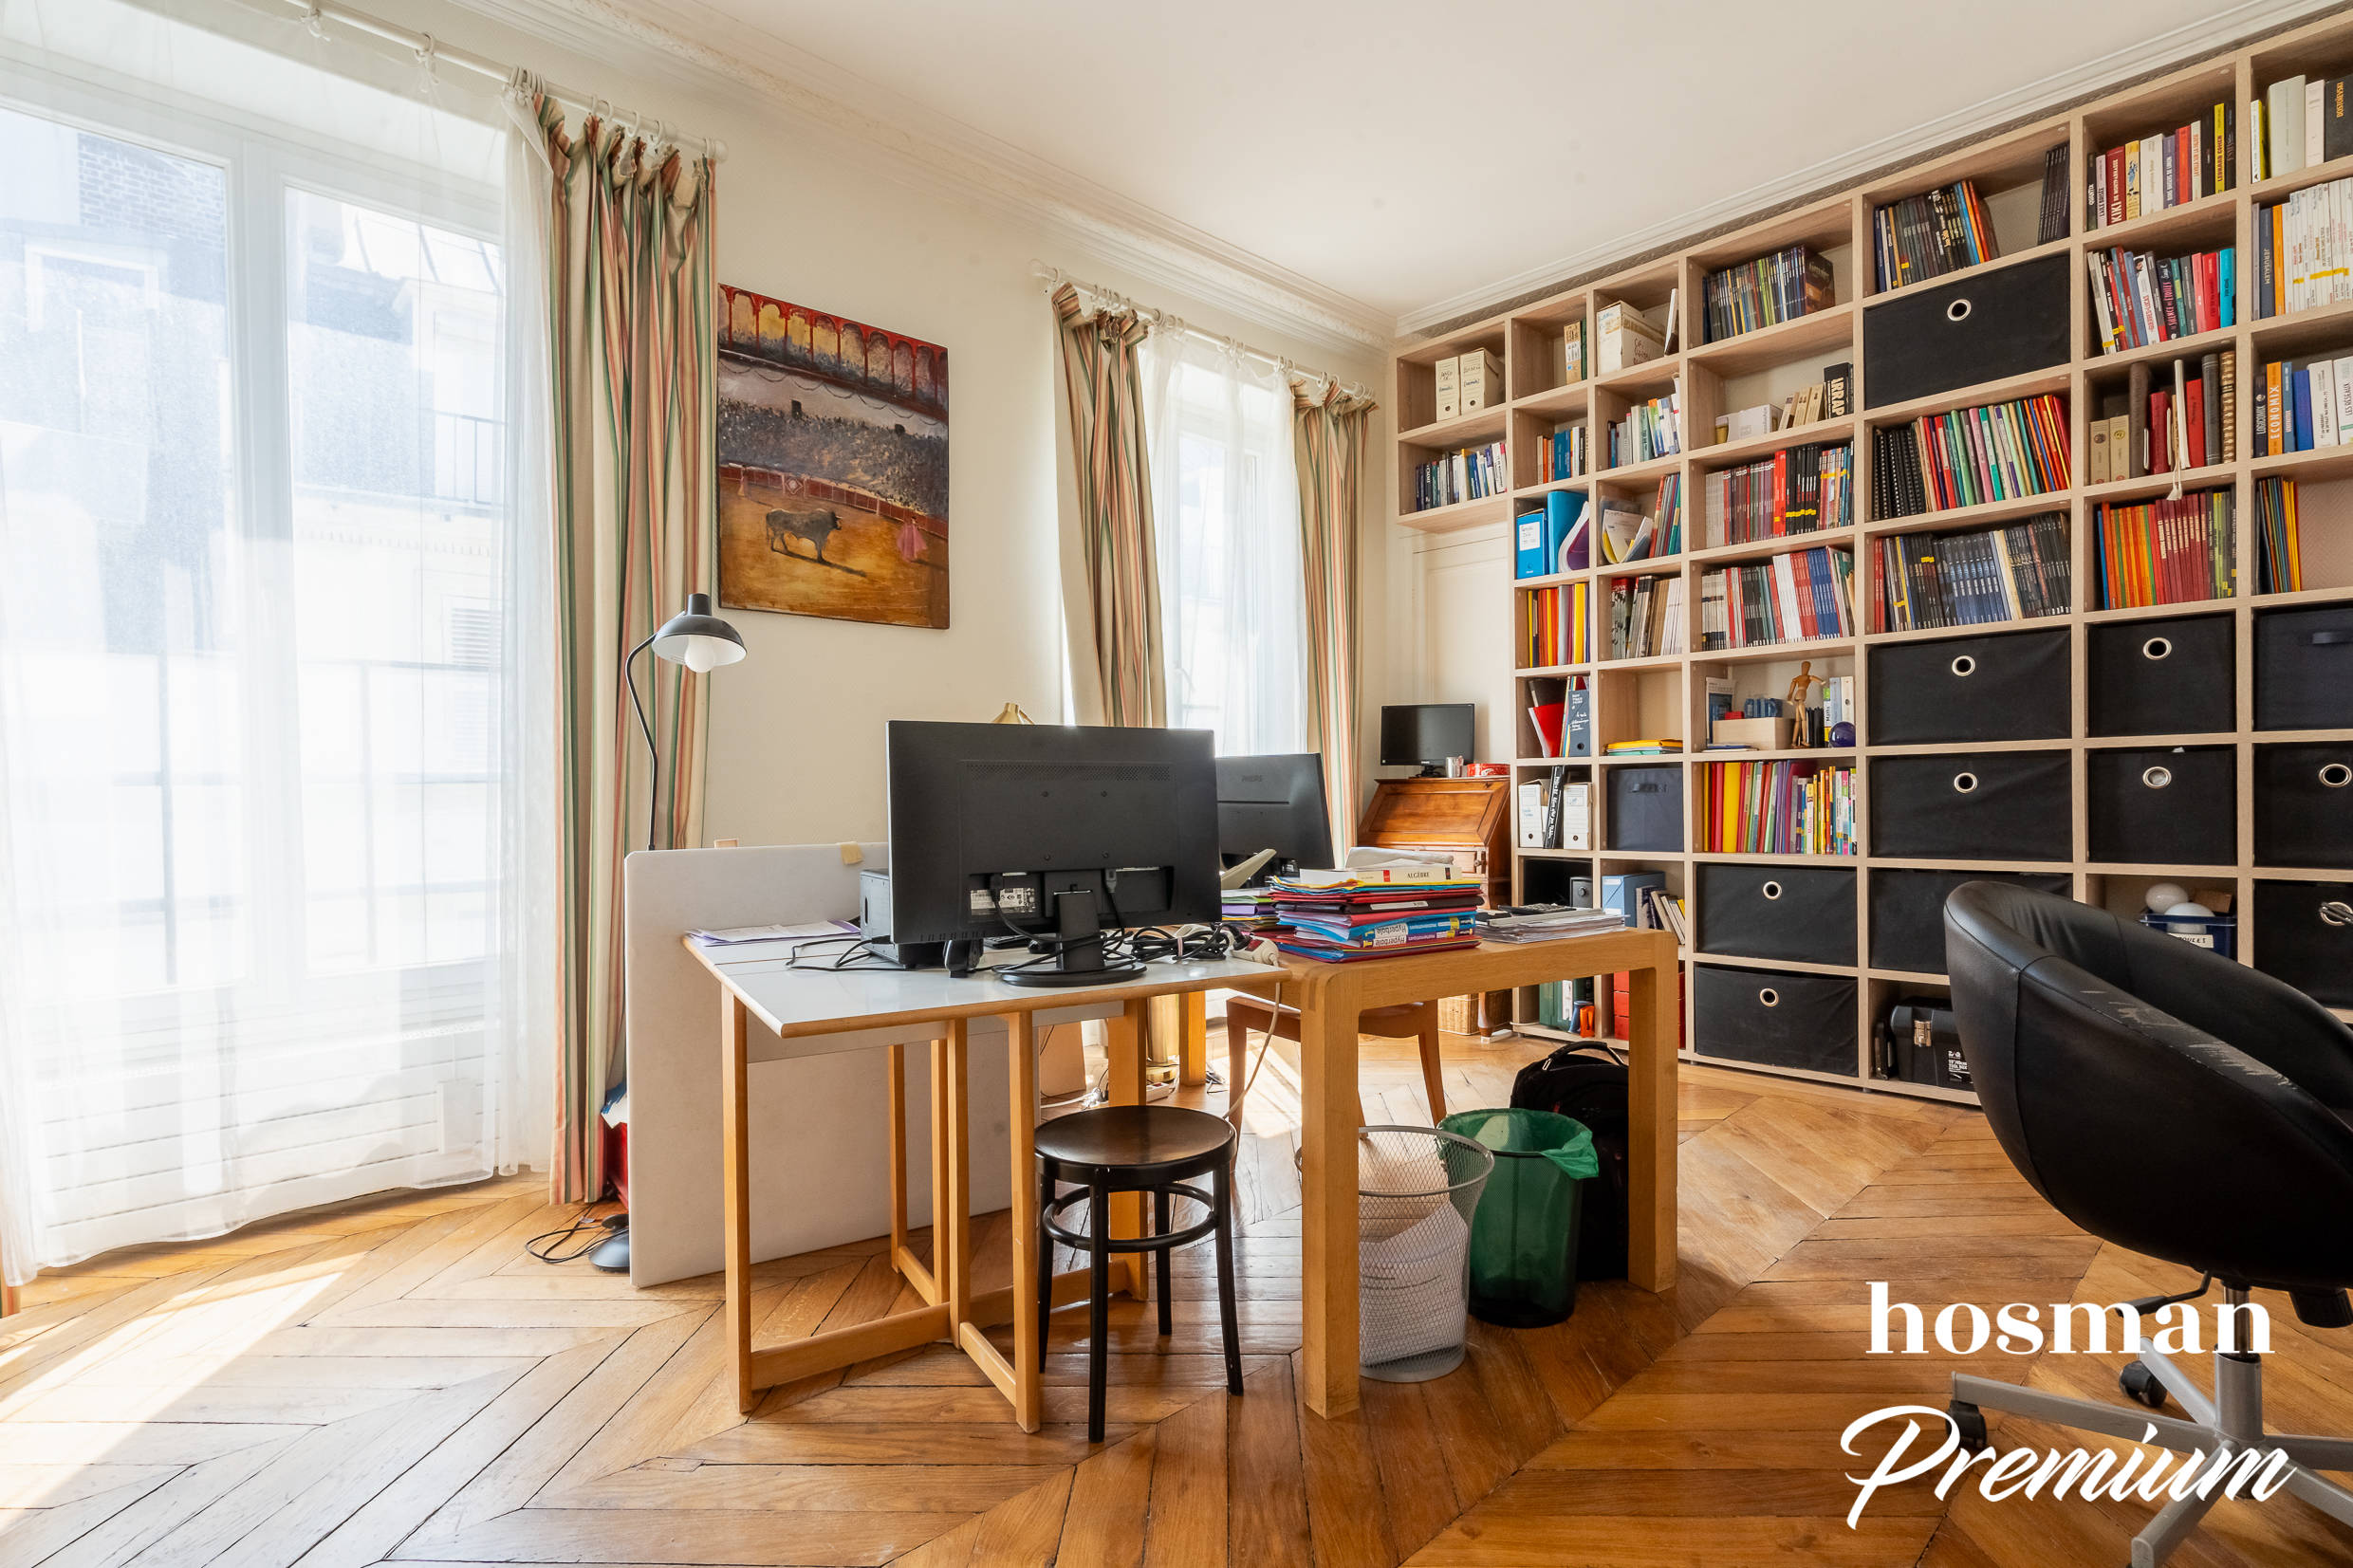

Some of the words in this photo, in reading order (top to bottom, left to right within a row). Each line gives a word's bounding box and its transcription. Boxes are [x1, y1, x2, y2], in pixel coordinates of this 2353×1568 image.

[2110, 201, 2122, 223] KIKI
[2263, 248, 2271, 285] JERUSALEM
[2255, 405, 2266, 434] LOGICOMIX
[2269, 384, 2280, 440] ECONOMIX
[1375, 935, 1407, 947] Hyperbole
[1376, 923, 1407, 936] Hyperbole
